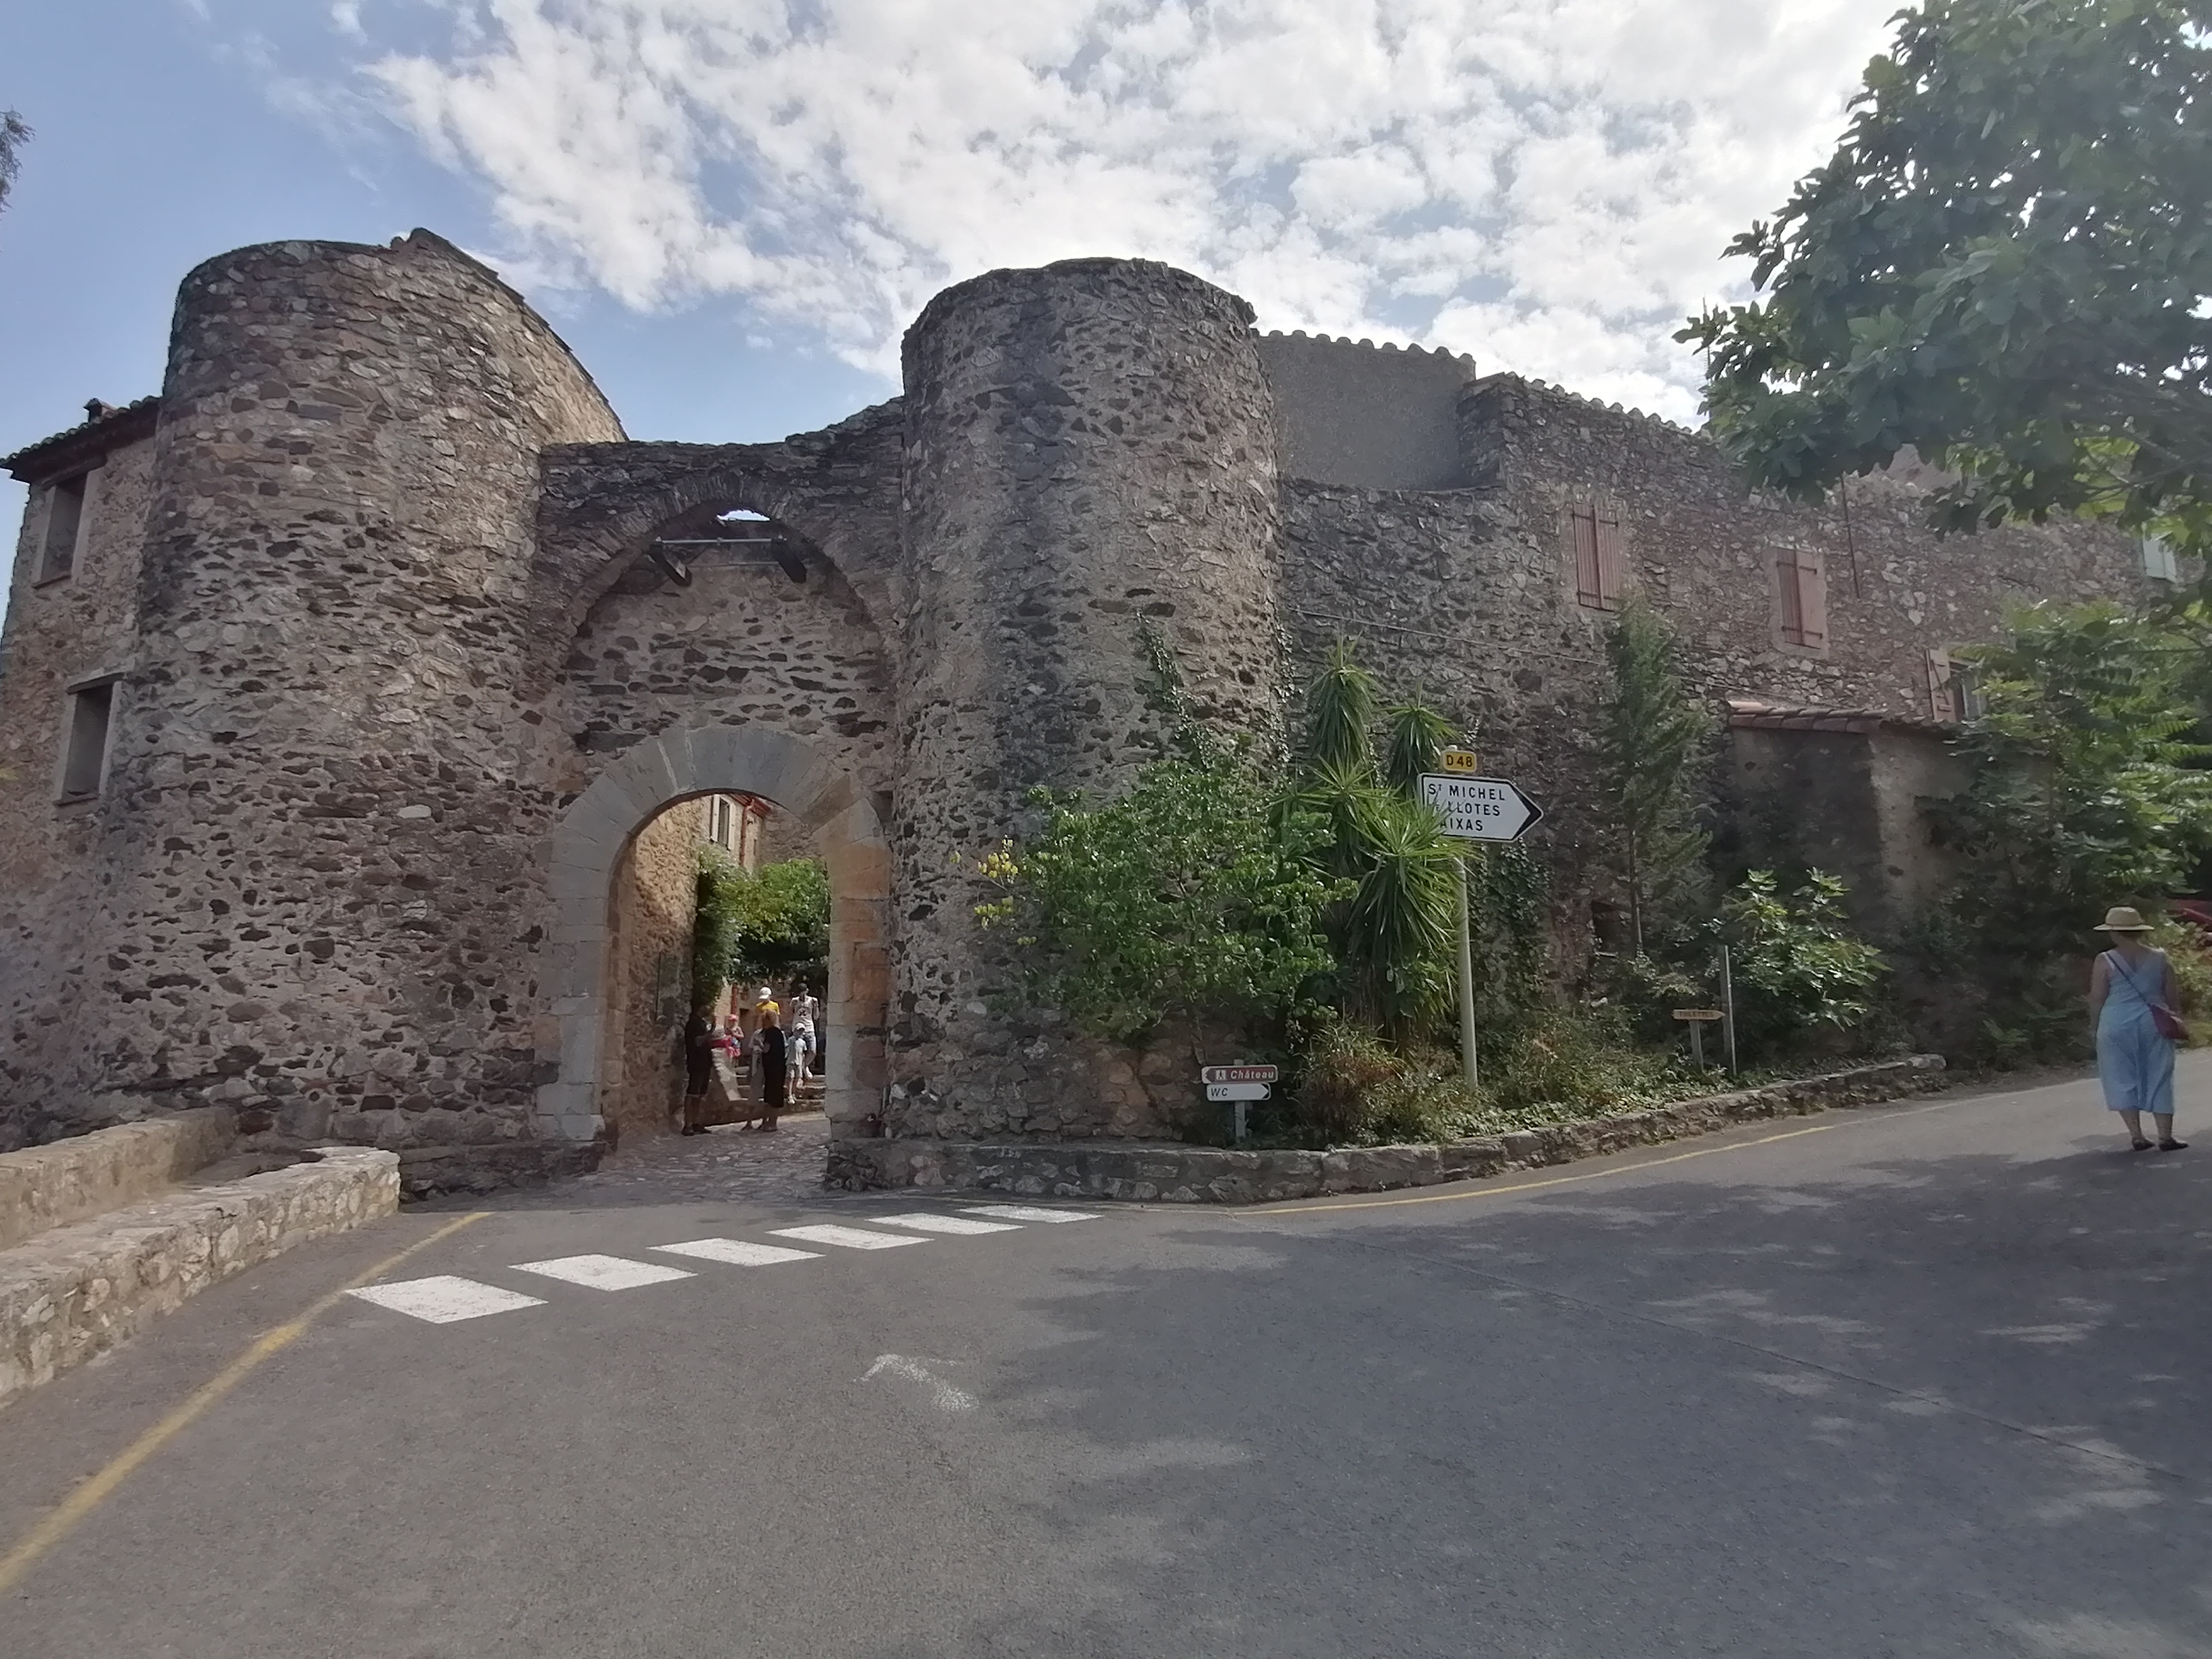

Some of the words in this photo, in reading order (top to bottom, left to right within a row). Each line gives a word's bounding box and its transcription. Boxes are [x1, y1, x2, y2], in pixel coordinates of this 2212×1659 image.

[1449, 785, 1506, 801] MICHEL
[1448, 801, 1500, 817] LLOTES
[1437, 817, 1483, 832] AIXAS
[1230, 1069, 1275, 1080] Château
[1210, 1087, 1229, 1097] WC
